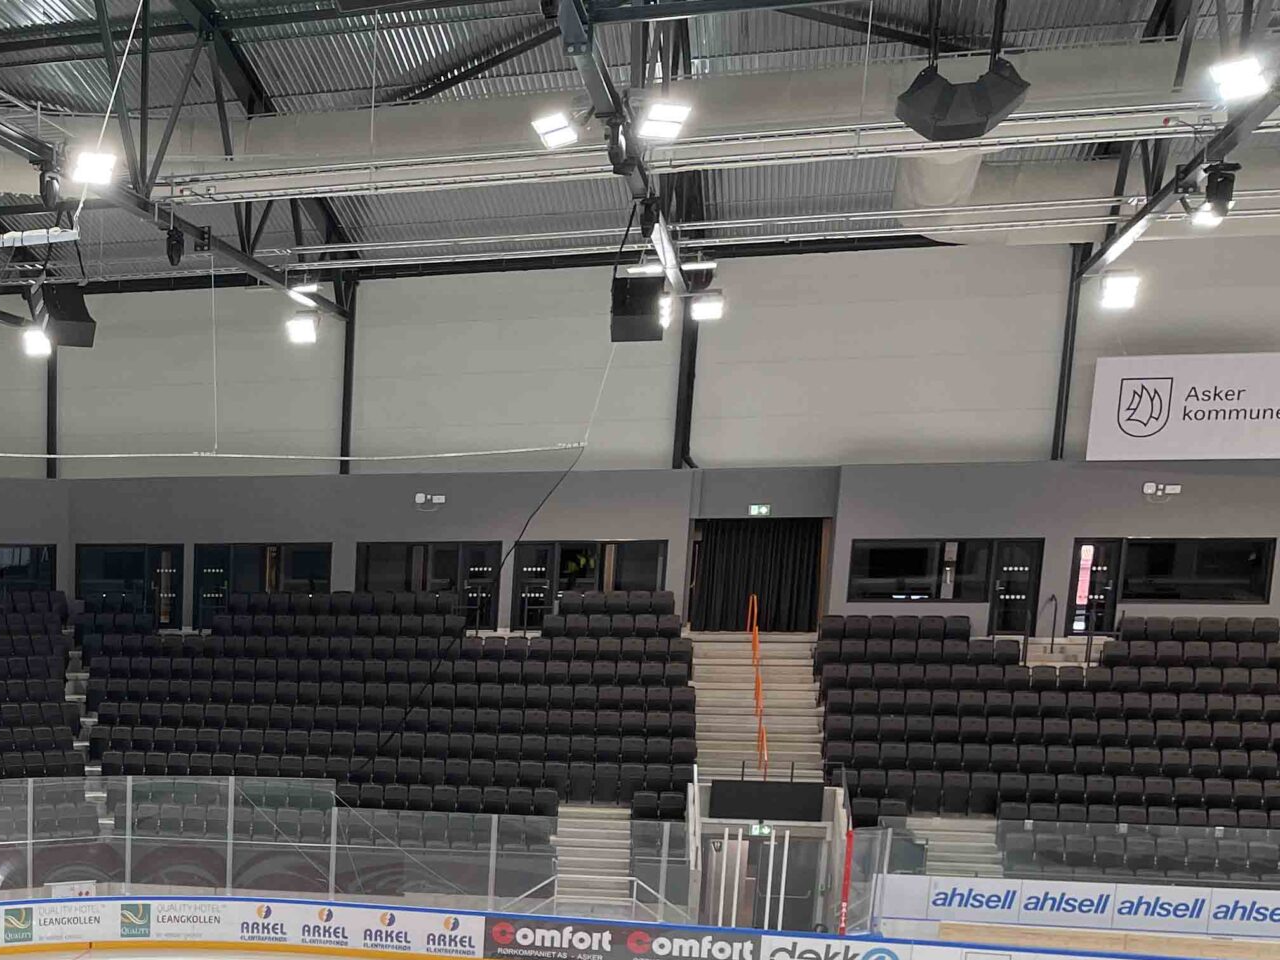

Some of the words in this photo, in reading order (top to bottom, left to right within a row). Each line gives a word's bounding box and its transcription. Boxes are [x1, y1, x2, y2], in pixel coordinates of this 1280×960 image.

[1184, 386, 1246, 402] Asker
[931, 887, 1017, 910] ahlsell
[1022, 891, 1110, 915] ahlsell
[1117, 895, 1206, 919] ahlsell
[1212, 899, 1280, 923] ahlse
[38, 915, 100, 927] LEANGKOLLEN
[156, 914, 221, 924] LEANGKOLLEN
[240, 921, 287, 935] ARKEL
[301, 924, 349, 939] ARKEL
[363, 928, 412, 944] ARKEL
[492, 920, 612, 952] Comfort
[426, 932, 476, 949] ARKEL
